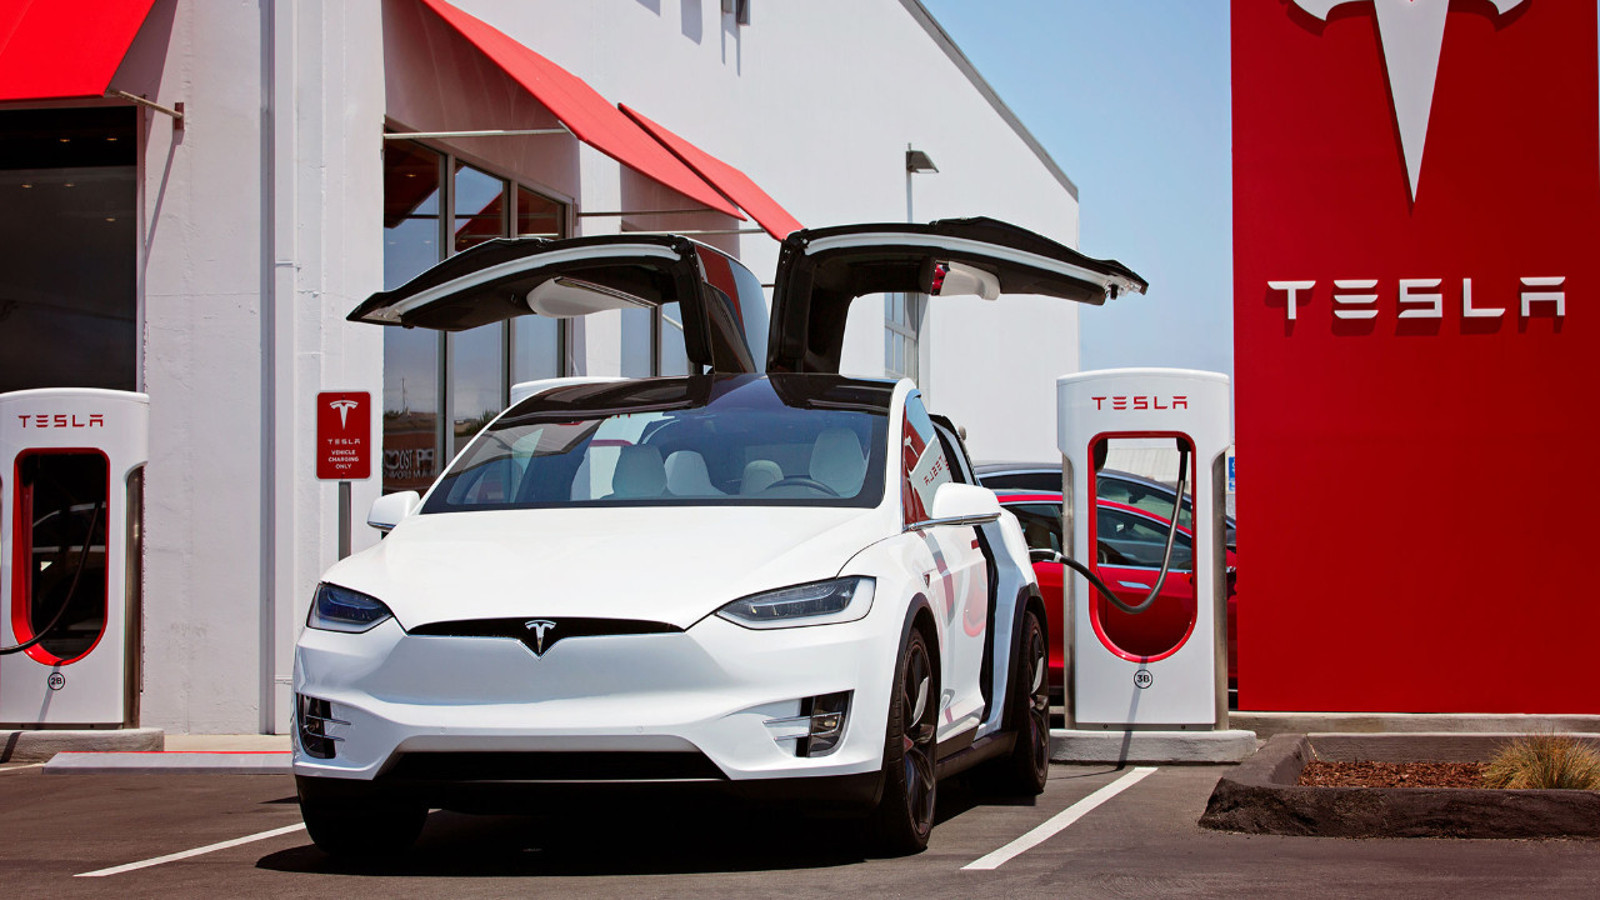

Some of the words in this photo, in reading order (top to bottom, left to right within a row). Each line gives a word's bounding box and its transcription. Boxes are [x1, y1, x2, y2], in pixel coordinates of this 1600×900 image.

[1267, 276, 1566, 320] TESLA
[1091, 396, 1188, 410] TESLA
[18, 414, 104, 428] TESLA
[51, 677, 62, 685] 2B
[1137, 674, 1150, 683] 3B
